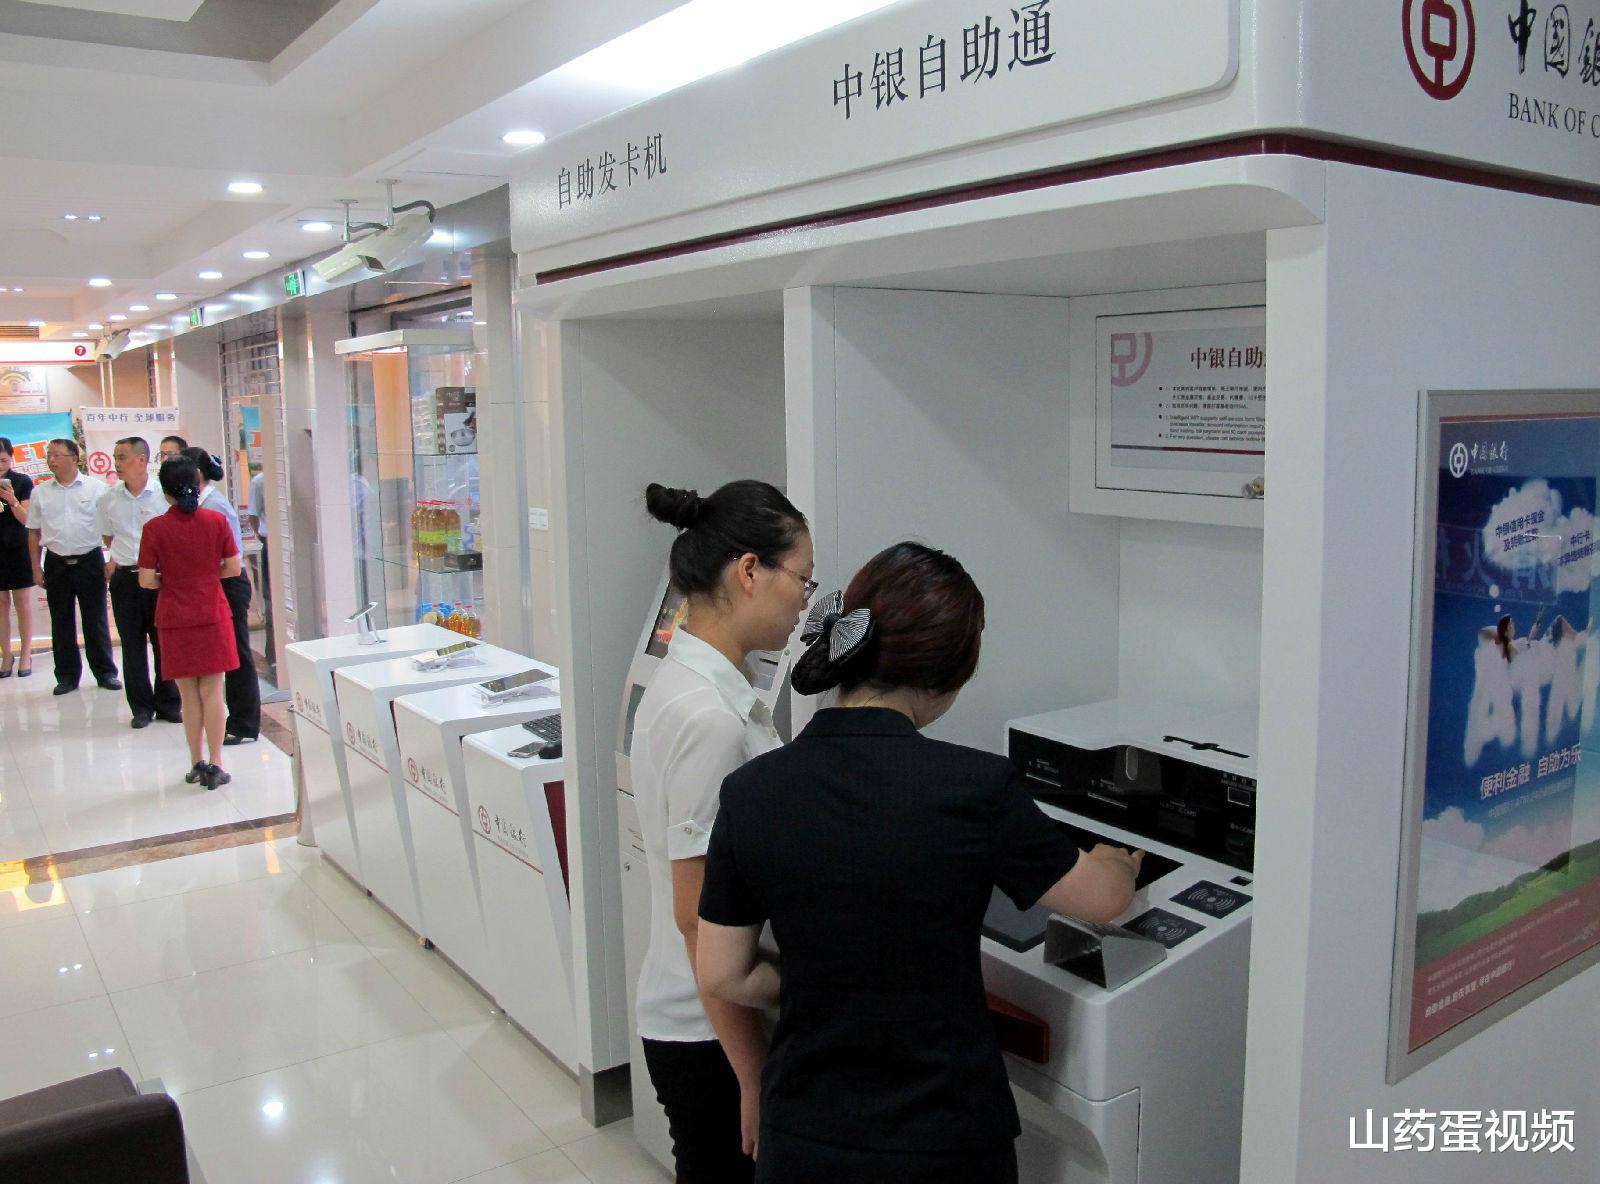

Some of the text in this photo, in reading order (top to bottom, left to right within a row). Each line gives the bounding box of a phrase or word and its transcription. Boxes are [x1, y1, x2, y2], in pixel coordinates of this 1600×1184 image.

[832, 1, 1057, 120] 中银自助通
[1508, 93, 1559, 129] BANK
[1564, 107, 1587, 135] OF
[557, 132, 668, 210] 自助发卡机
[1190, 346, 1265, 370] 中银自助
[86, 412, 176, 423] 百年中行 全球服务
[1480, 762, 1531, 800] 便利金融
[1537, 743, 1583, 779] 自助为乐
